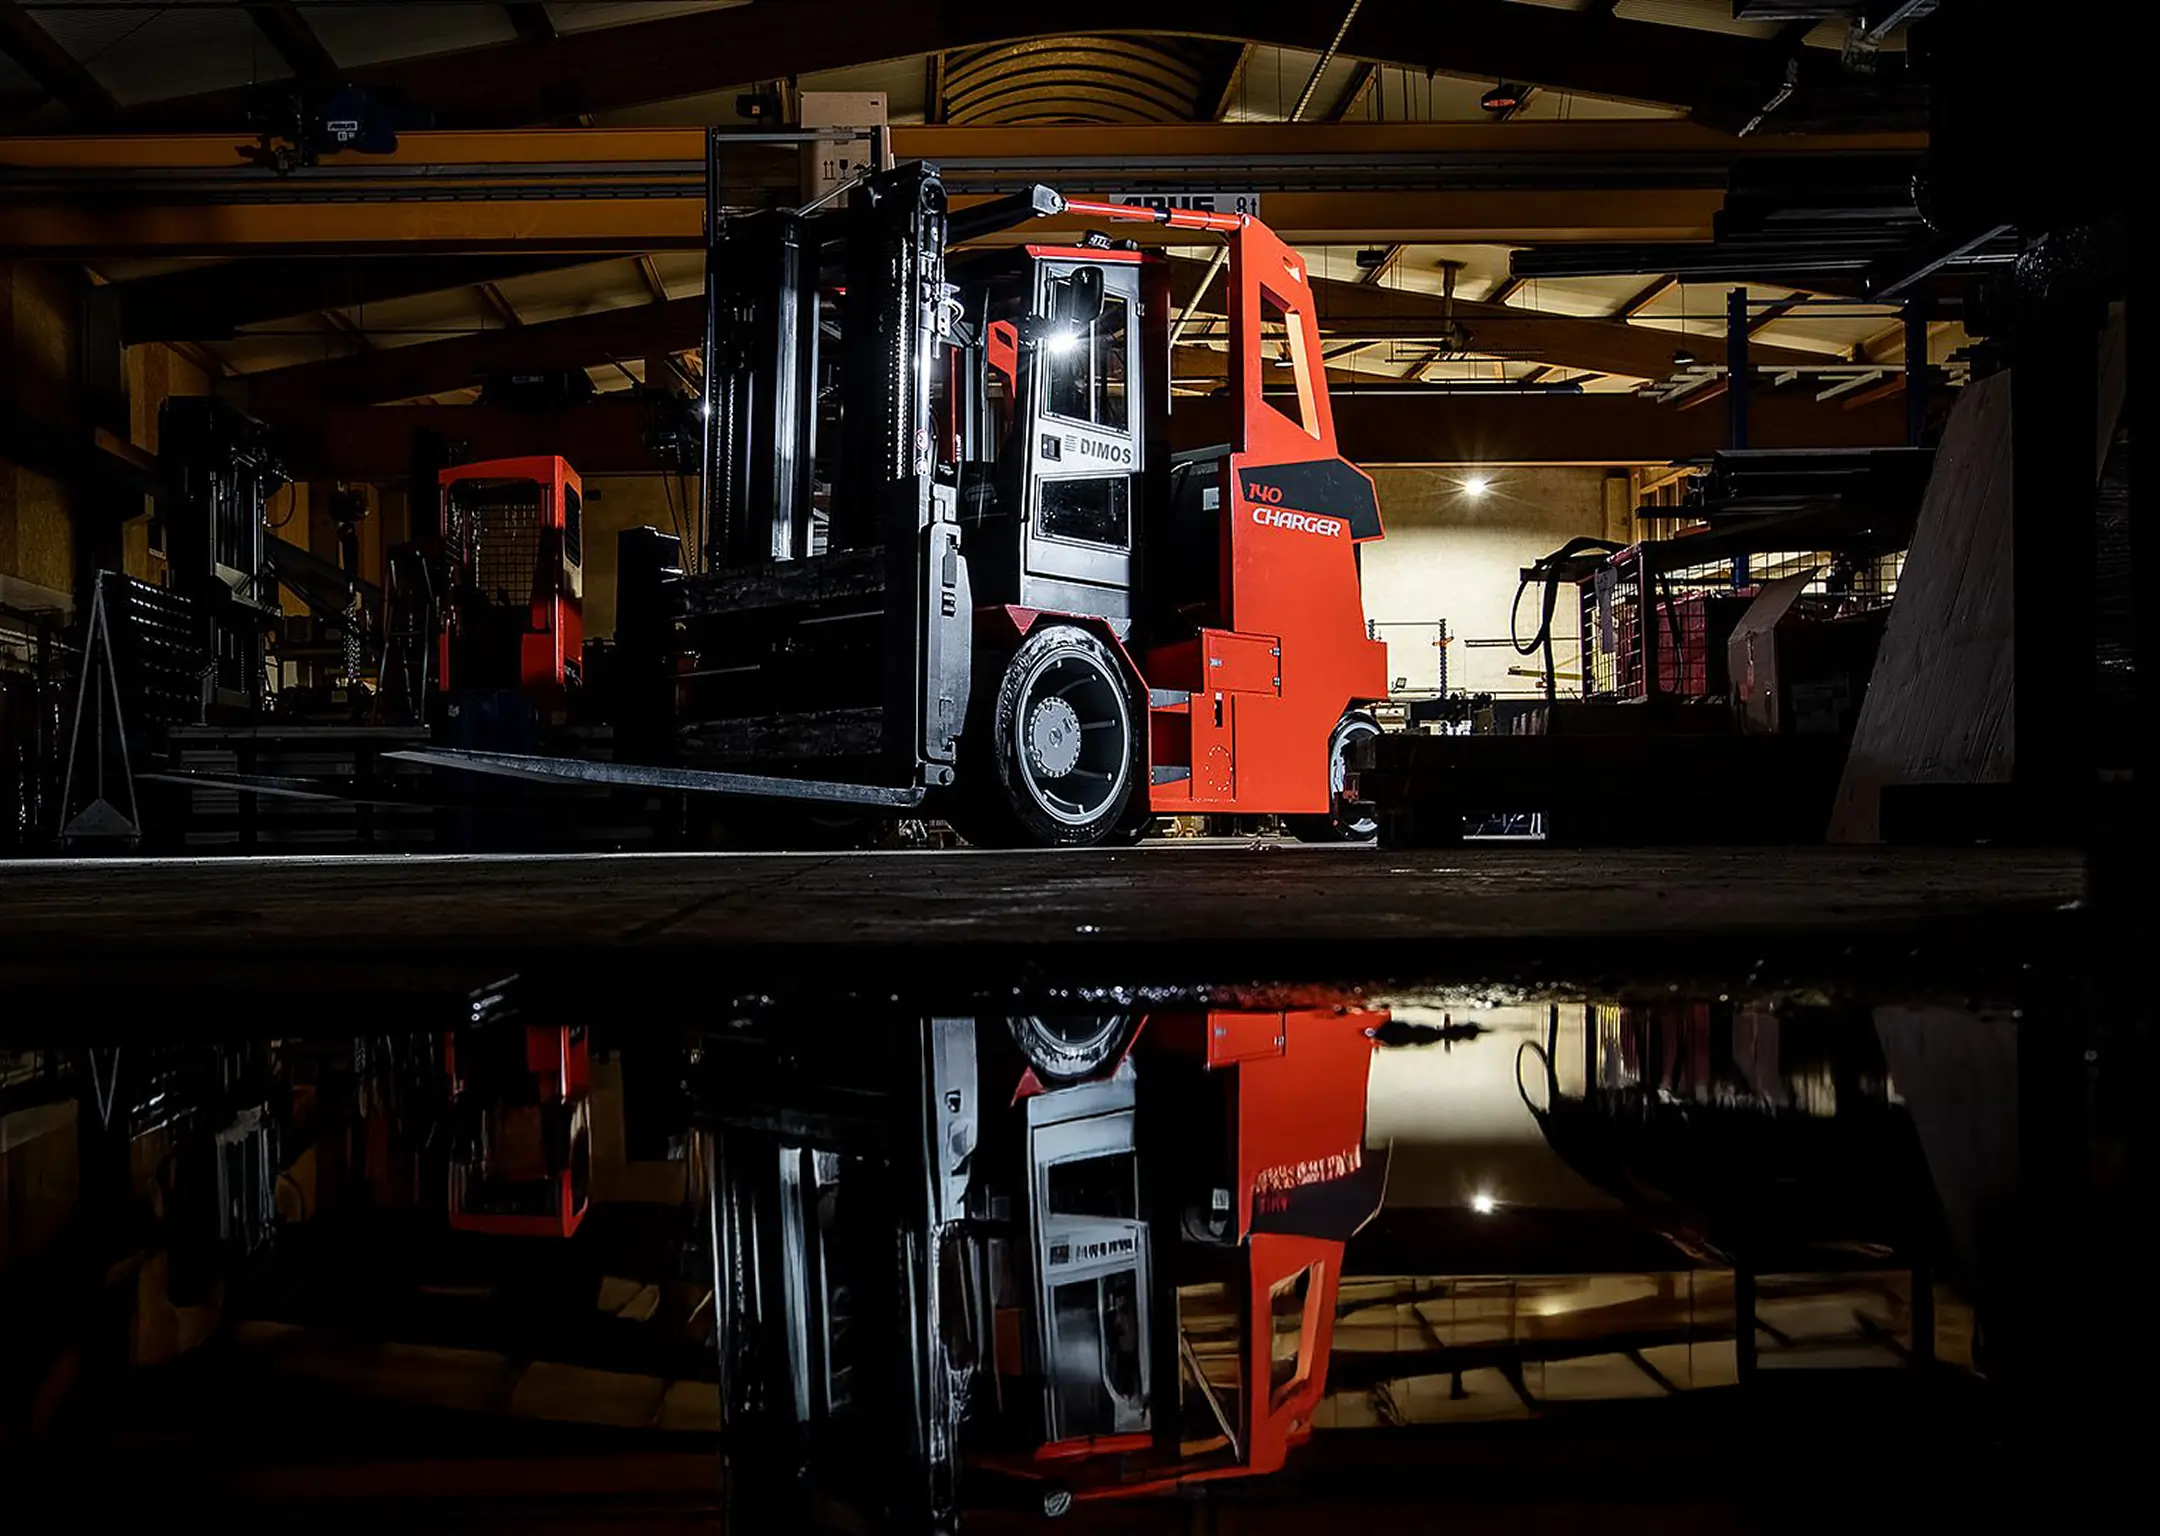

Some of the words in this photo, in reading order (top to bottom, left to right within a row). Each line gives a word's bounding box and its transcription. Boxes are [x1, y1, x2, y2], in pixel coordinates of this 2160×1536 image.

[1081, 438, 1131, 464] DIMOS
[1247, 481, 1283, 504] 140
[1252, 507, 1341, 537] CHARGER
